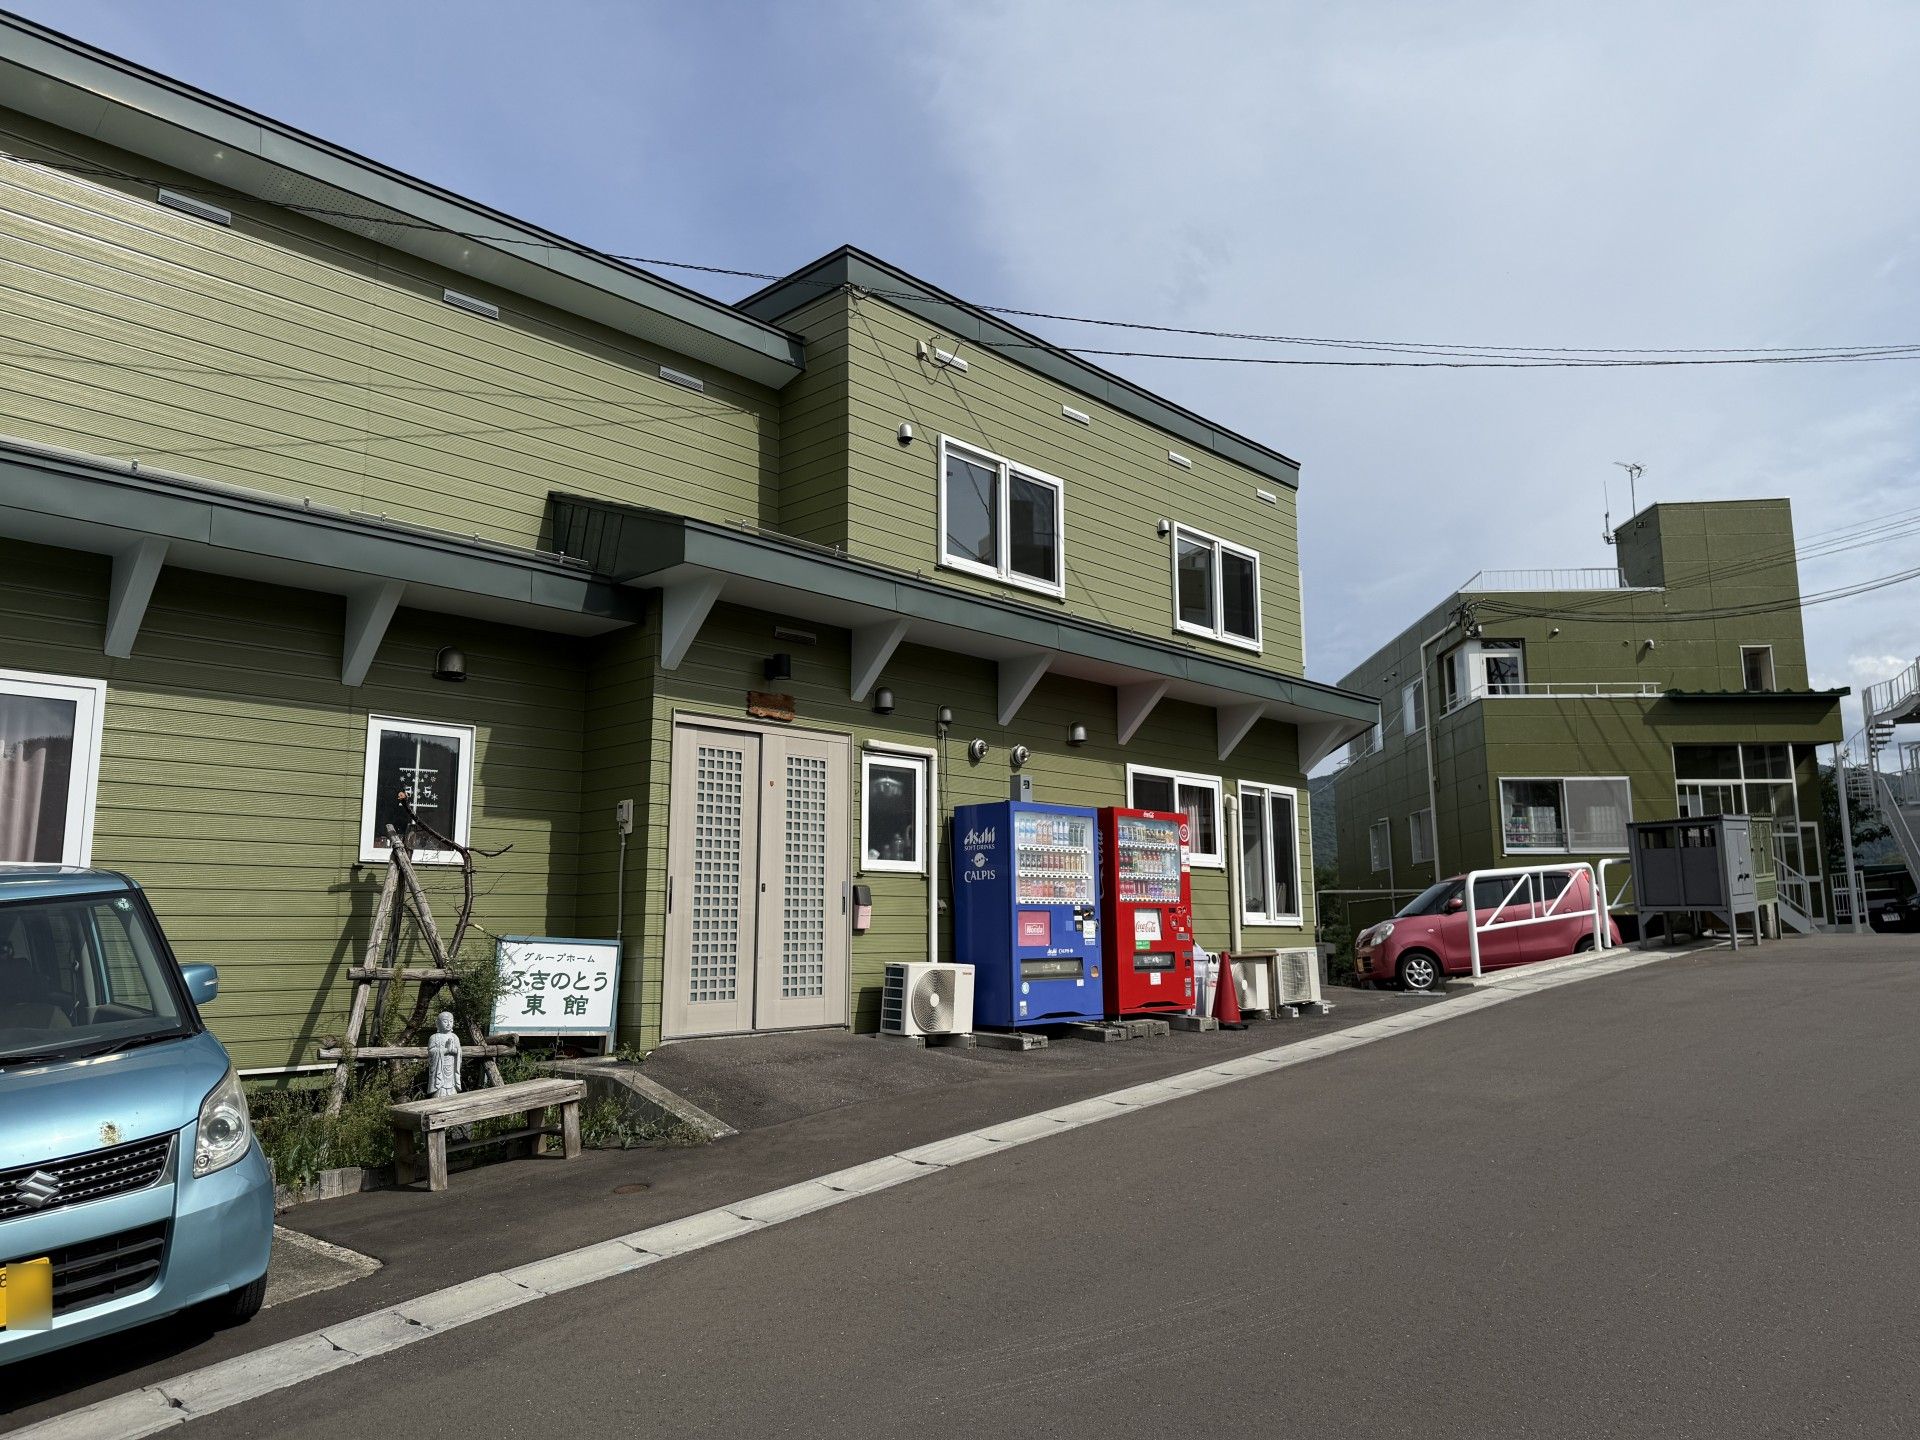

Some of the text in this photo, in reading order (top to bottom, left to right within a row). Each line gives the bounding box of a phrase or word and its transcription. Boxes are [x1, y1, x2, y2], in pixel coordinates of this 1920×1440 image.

[964, 827, 995, 845] Asahi
[964, 870, 996, 883] CALPIS
[524, 952, 595, 963] グループホーム
[507, 970, 608, 992] ふきのとう
